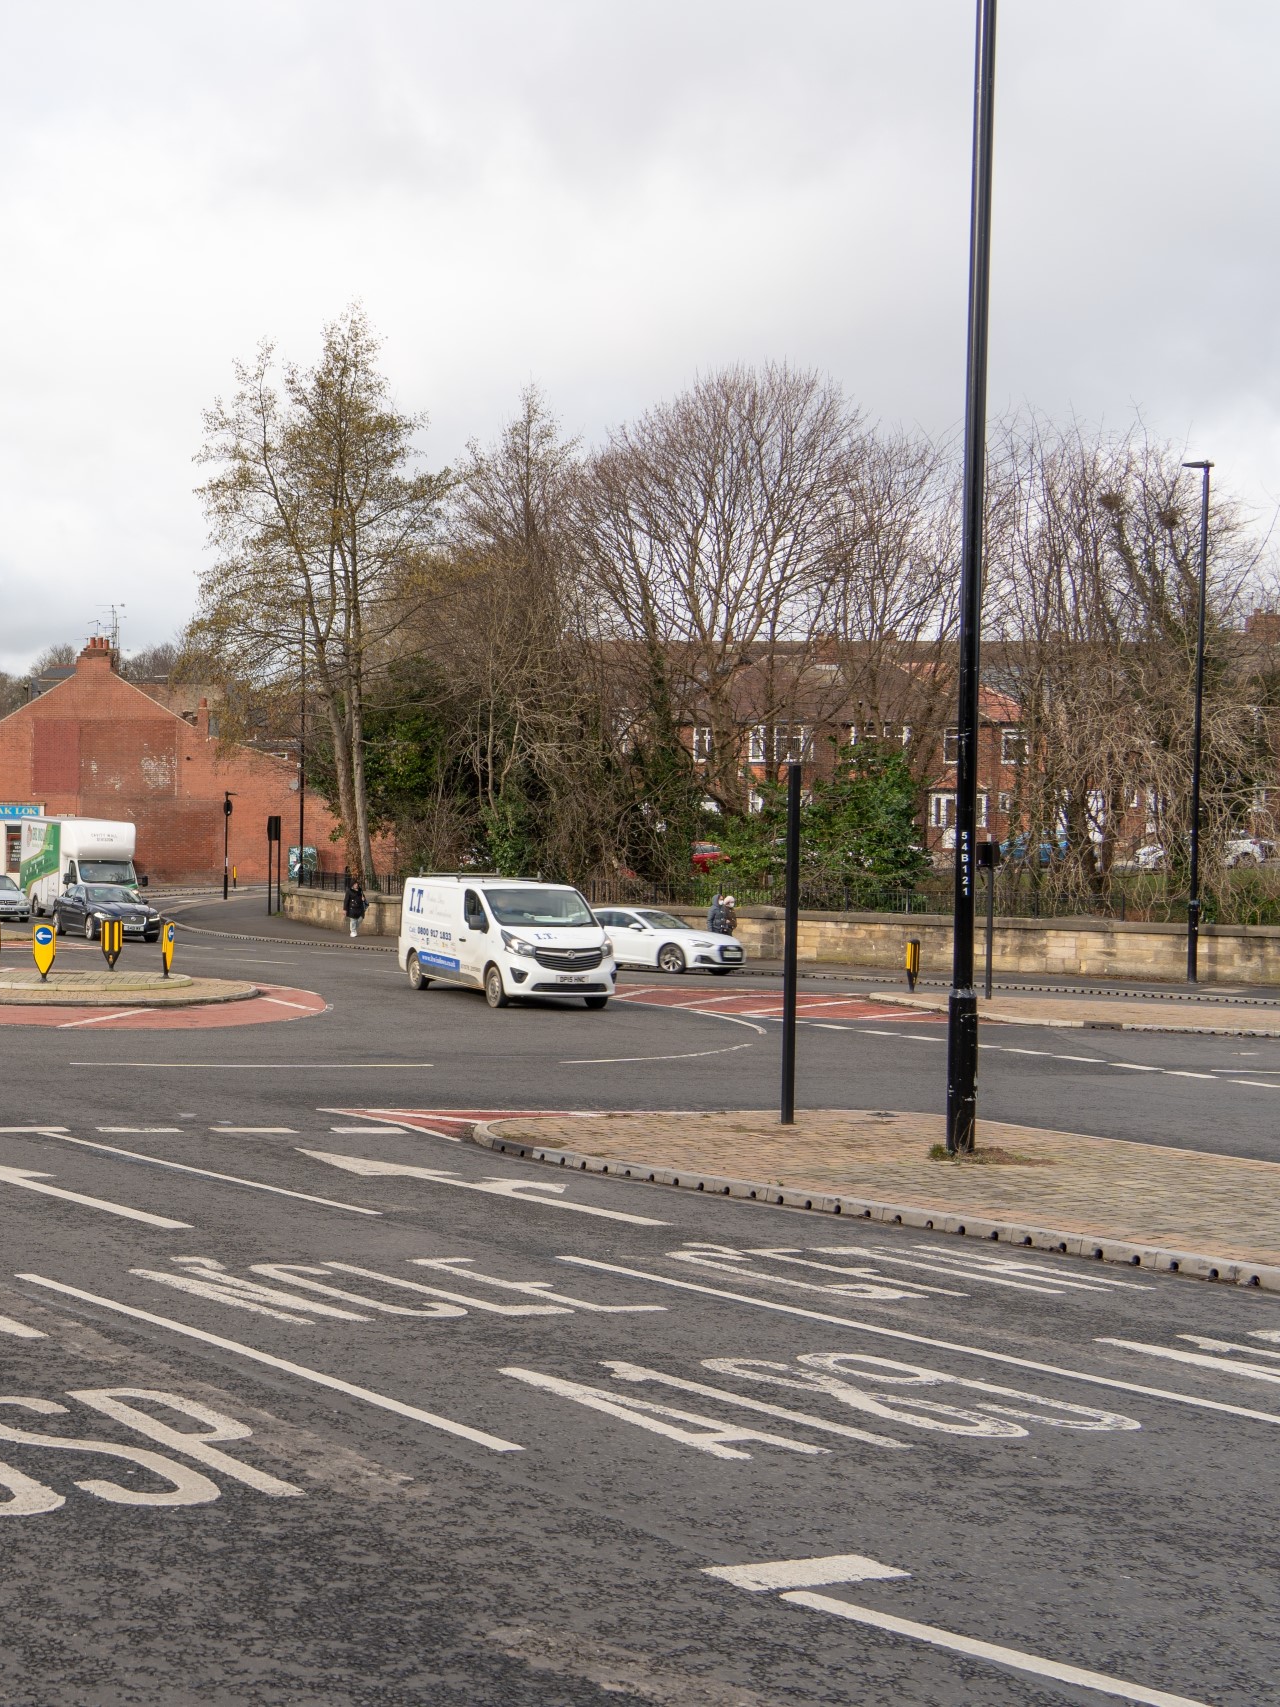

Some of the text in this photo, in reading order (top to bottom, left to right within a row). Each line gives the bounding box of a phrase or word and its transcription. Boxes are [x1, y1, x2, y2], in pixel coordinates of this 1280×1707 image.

[961, 831, 970, 896] 54B121
[409, 887, 424, 914] I.T.
[417, 926, 429, 936] 0800
[430, 929, 439, 938] 917
[440, 931, 452, 941] 1833
[499, 1351, 1143, 1461] A189
